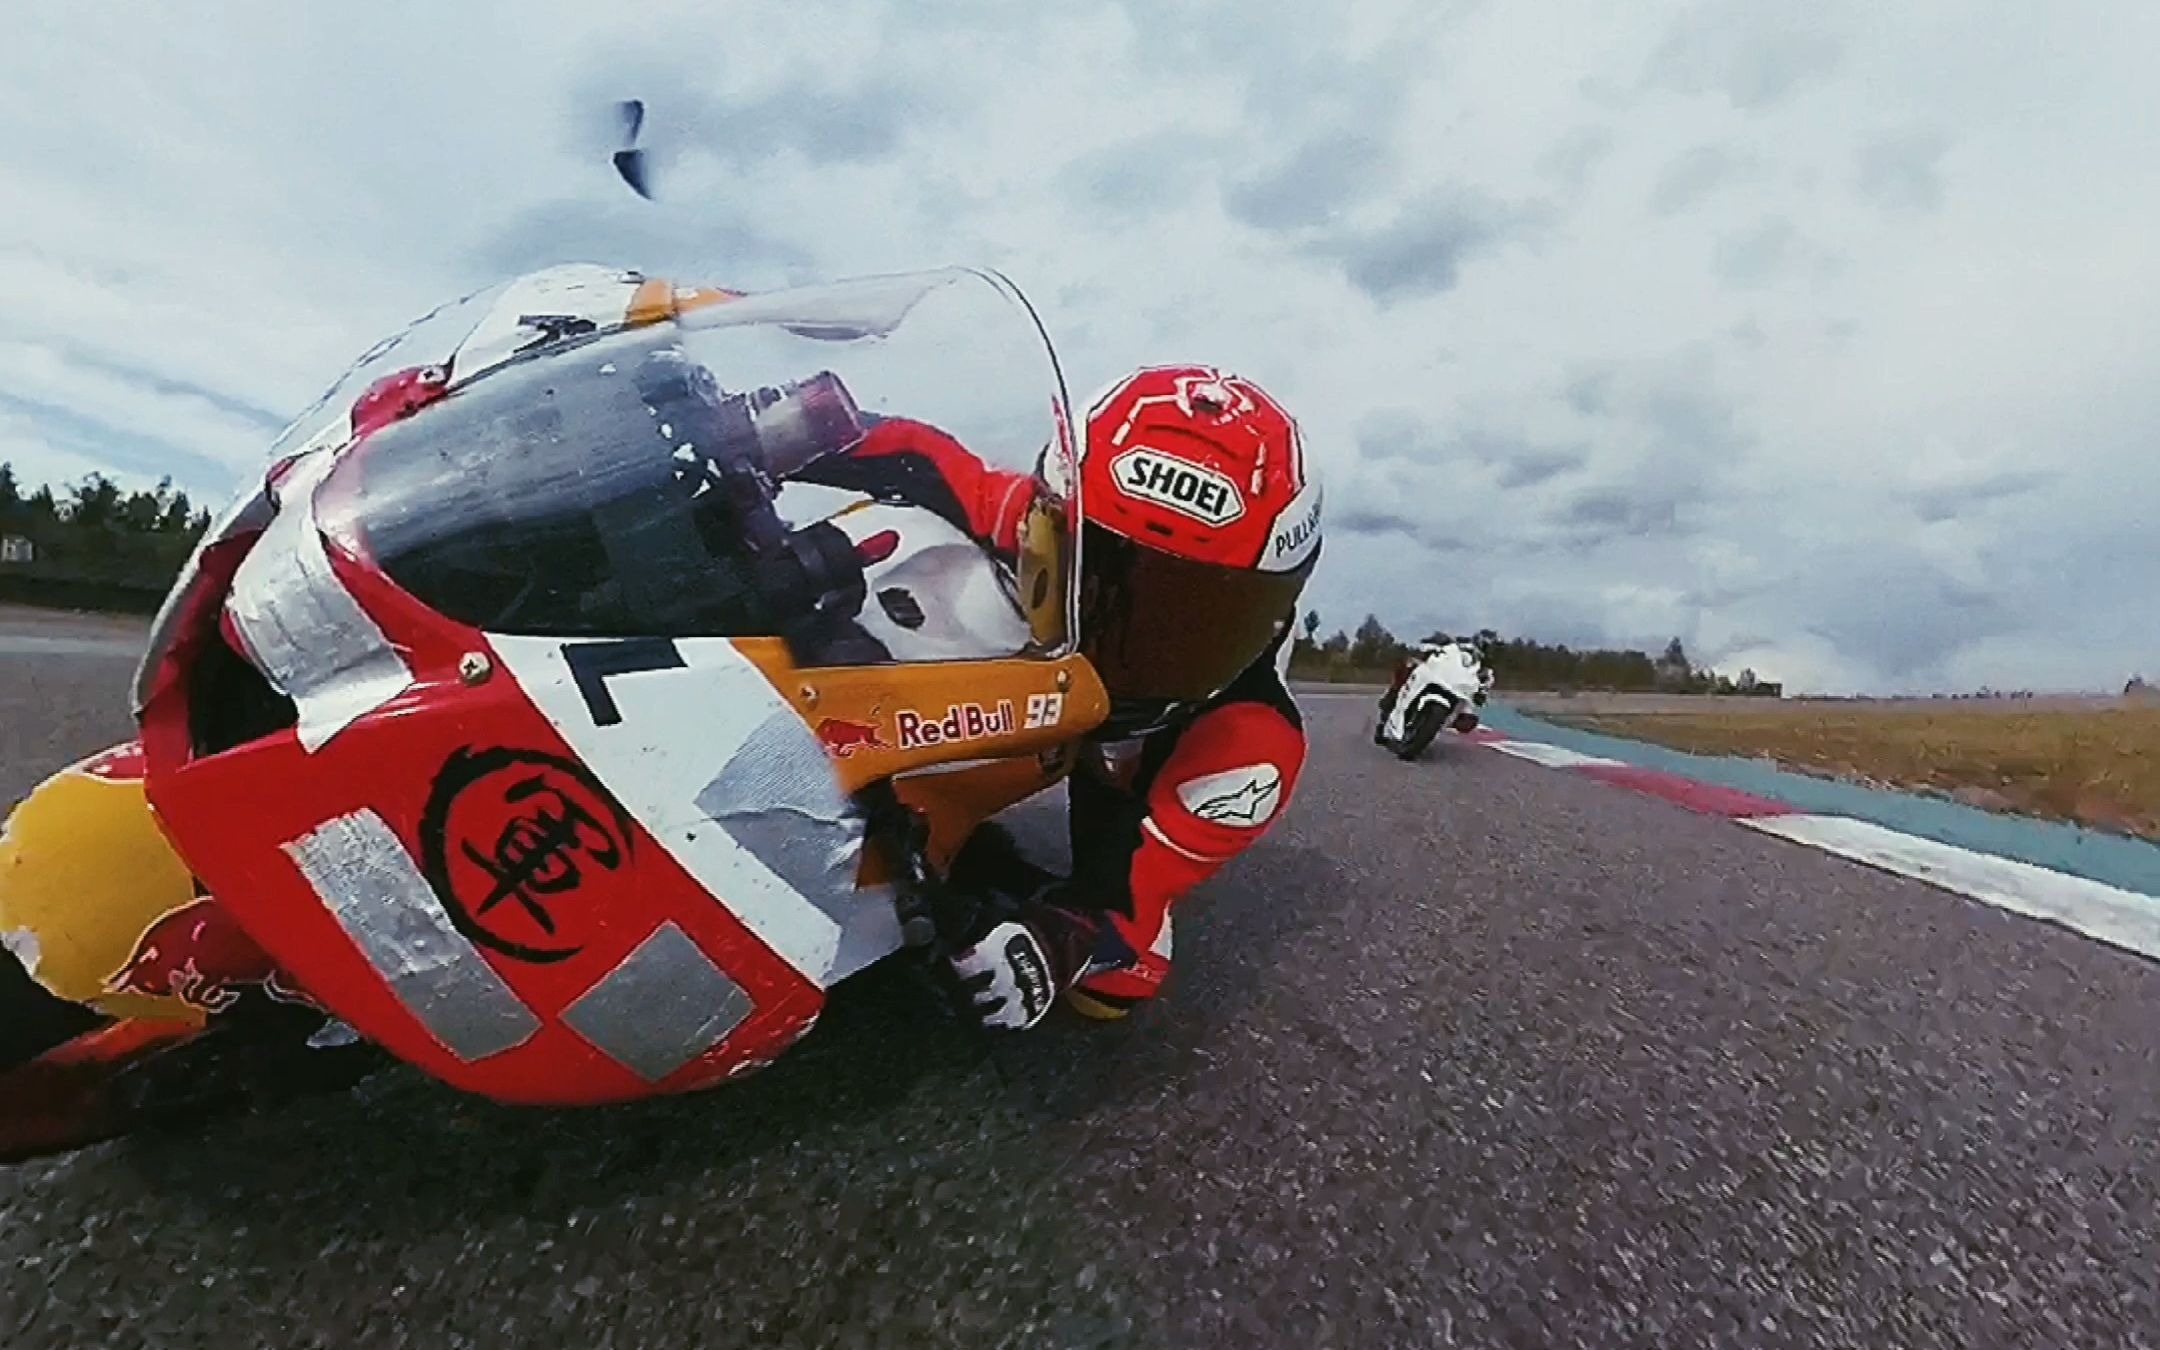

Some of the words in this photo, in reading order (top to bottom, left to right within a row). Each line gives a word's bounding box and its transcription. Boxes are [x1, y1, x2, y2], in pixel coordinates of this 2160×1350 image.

[1128, 456, 1229, 516] SHOEI
[897, 704, 963, 749] Red
[962, 699, 1016, 740] Bull
[1024, 694, 1063, 729] 93
